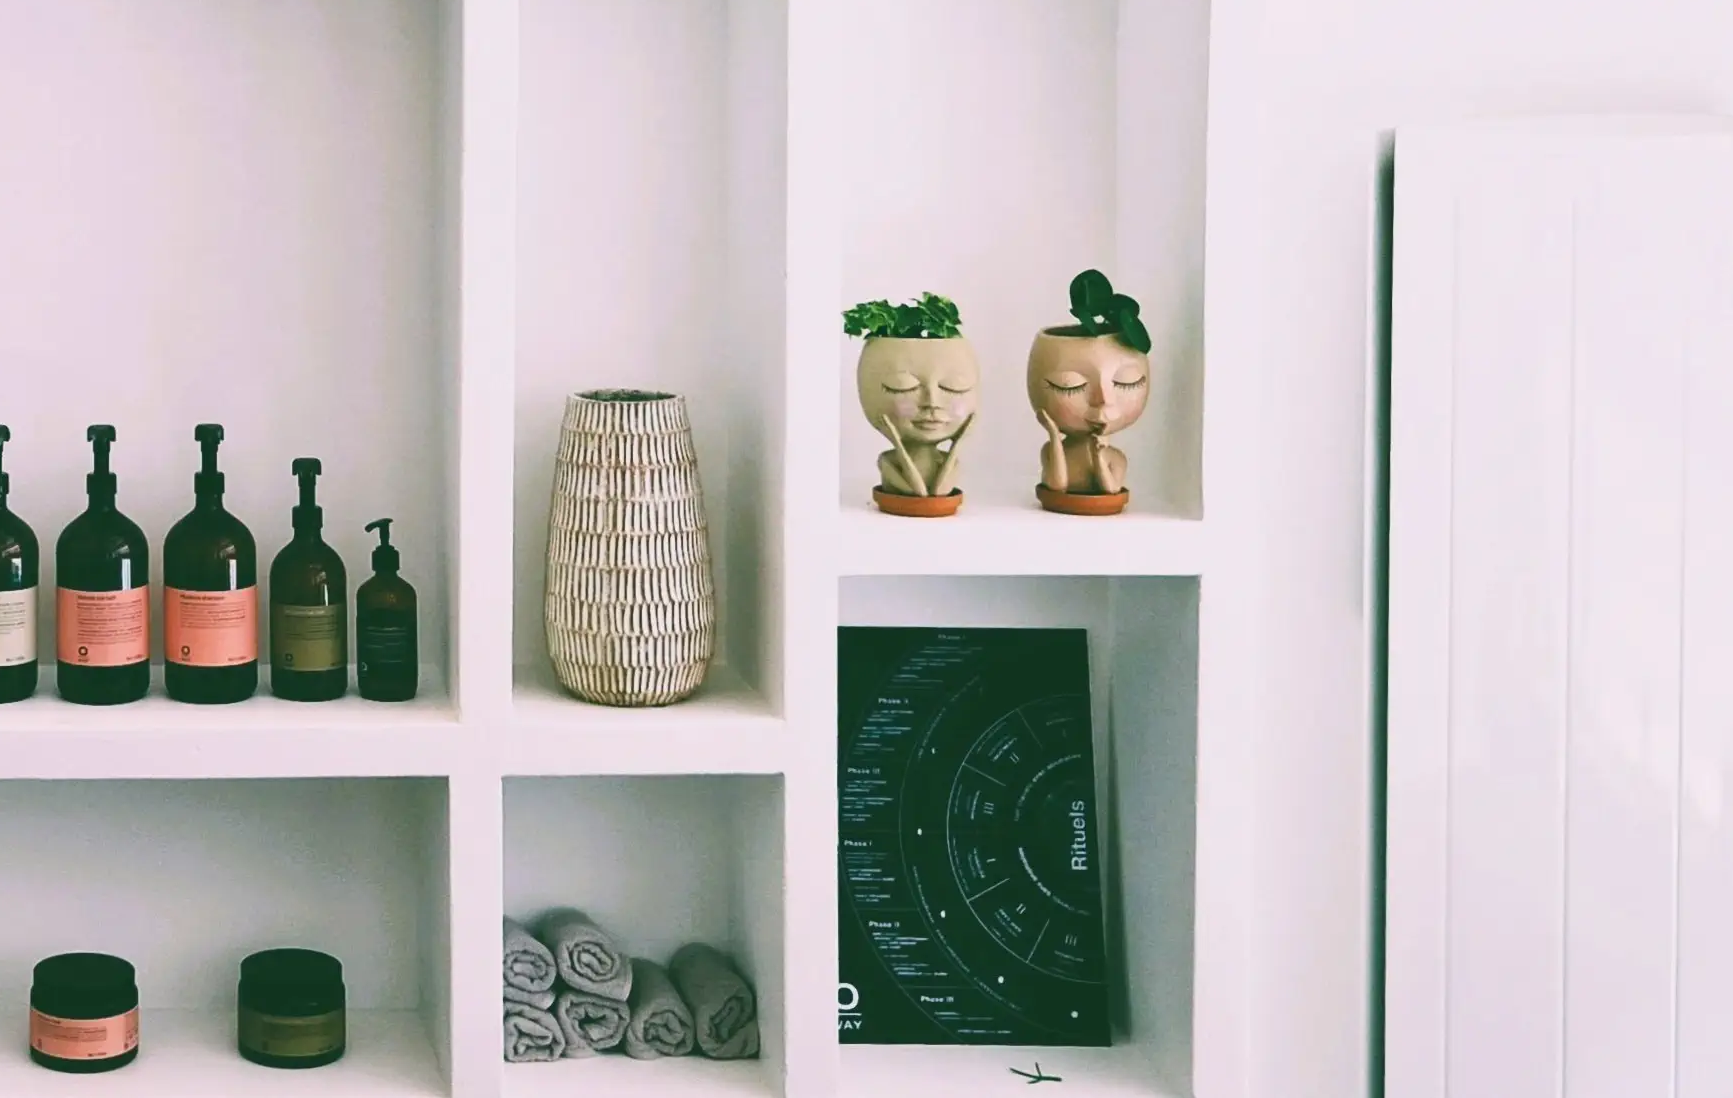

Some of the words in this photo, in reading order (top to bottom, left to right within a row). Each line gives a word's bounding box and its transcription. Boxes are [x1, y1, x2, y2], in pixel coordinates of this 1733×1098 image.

[1069, 799, 1089, 871] Rituels
[843, 839, 866, 847] Phase
[868, 920, 892, 928] Phase
[920, 995, 944, 1003] Phase
